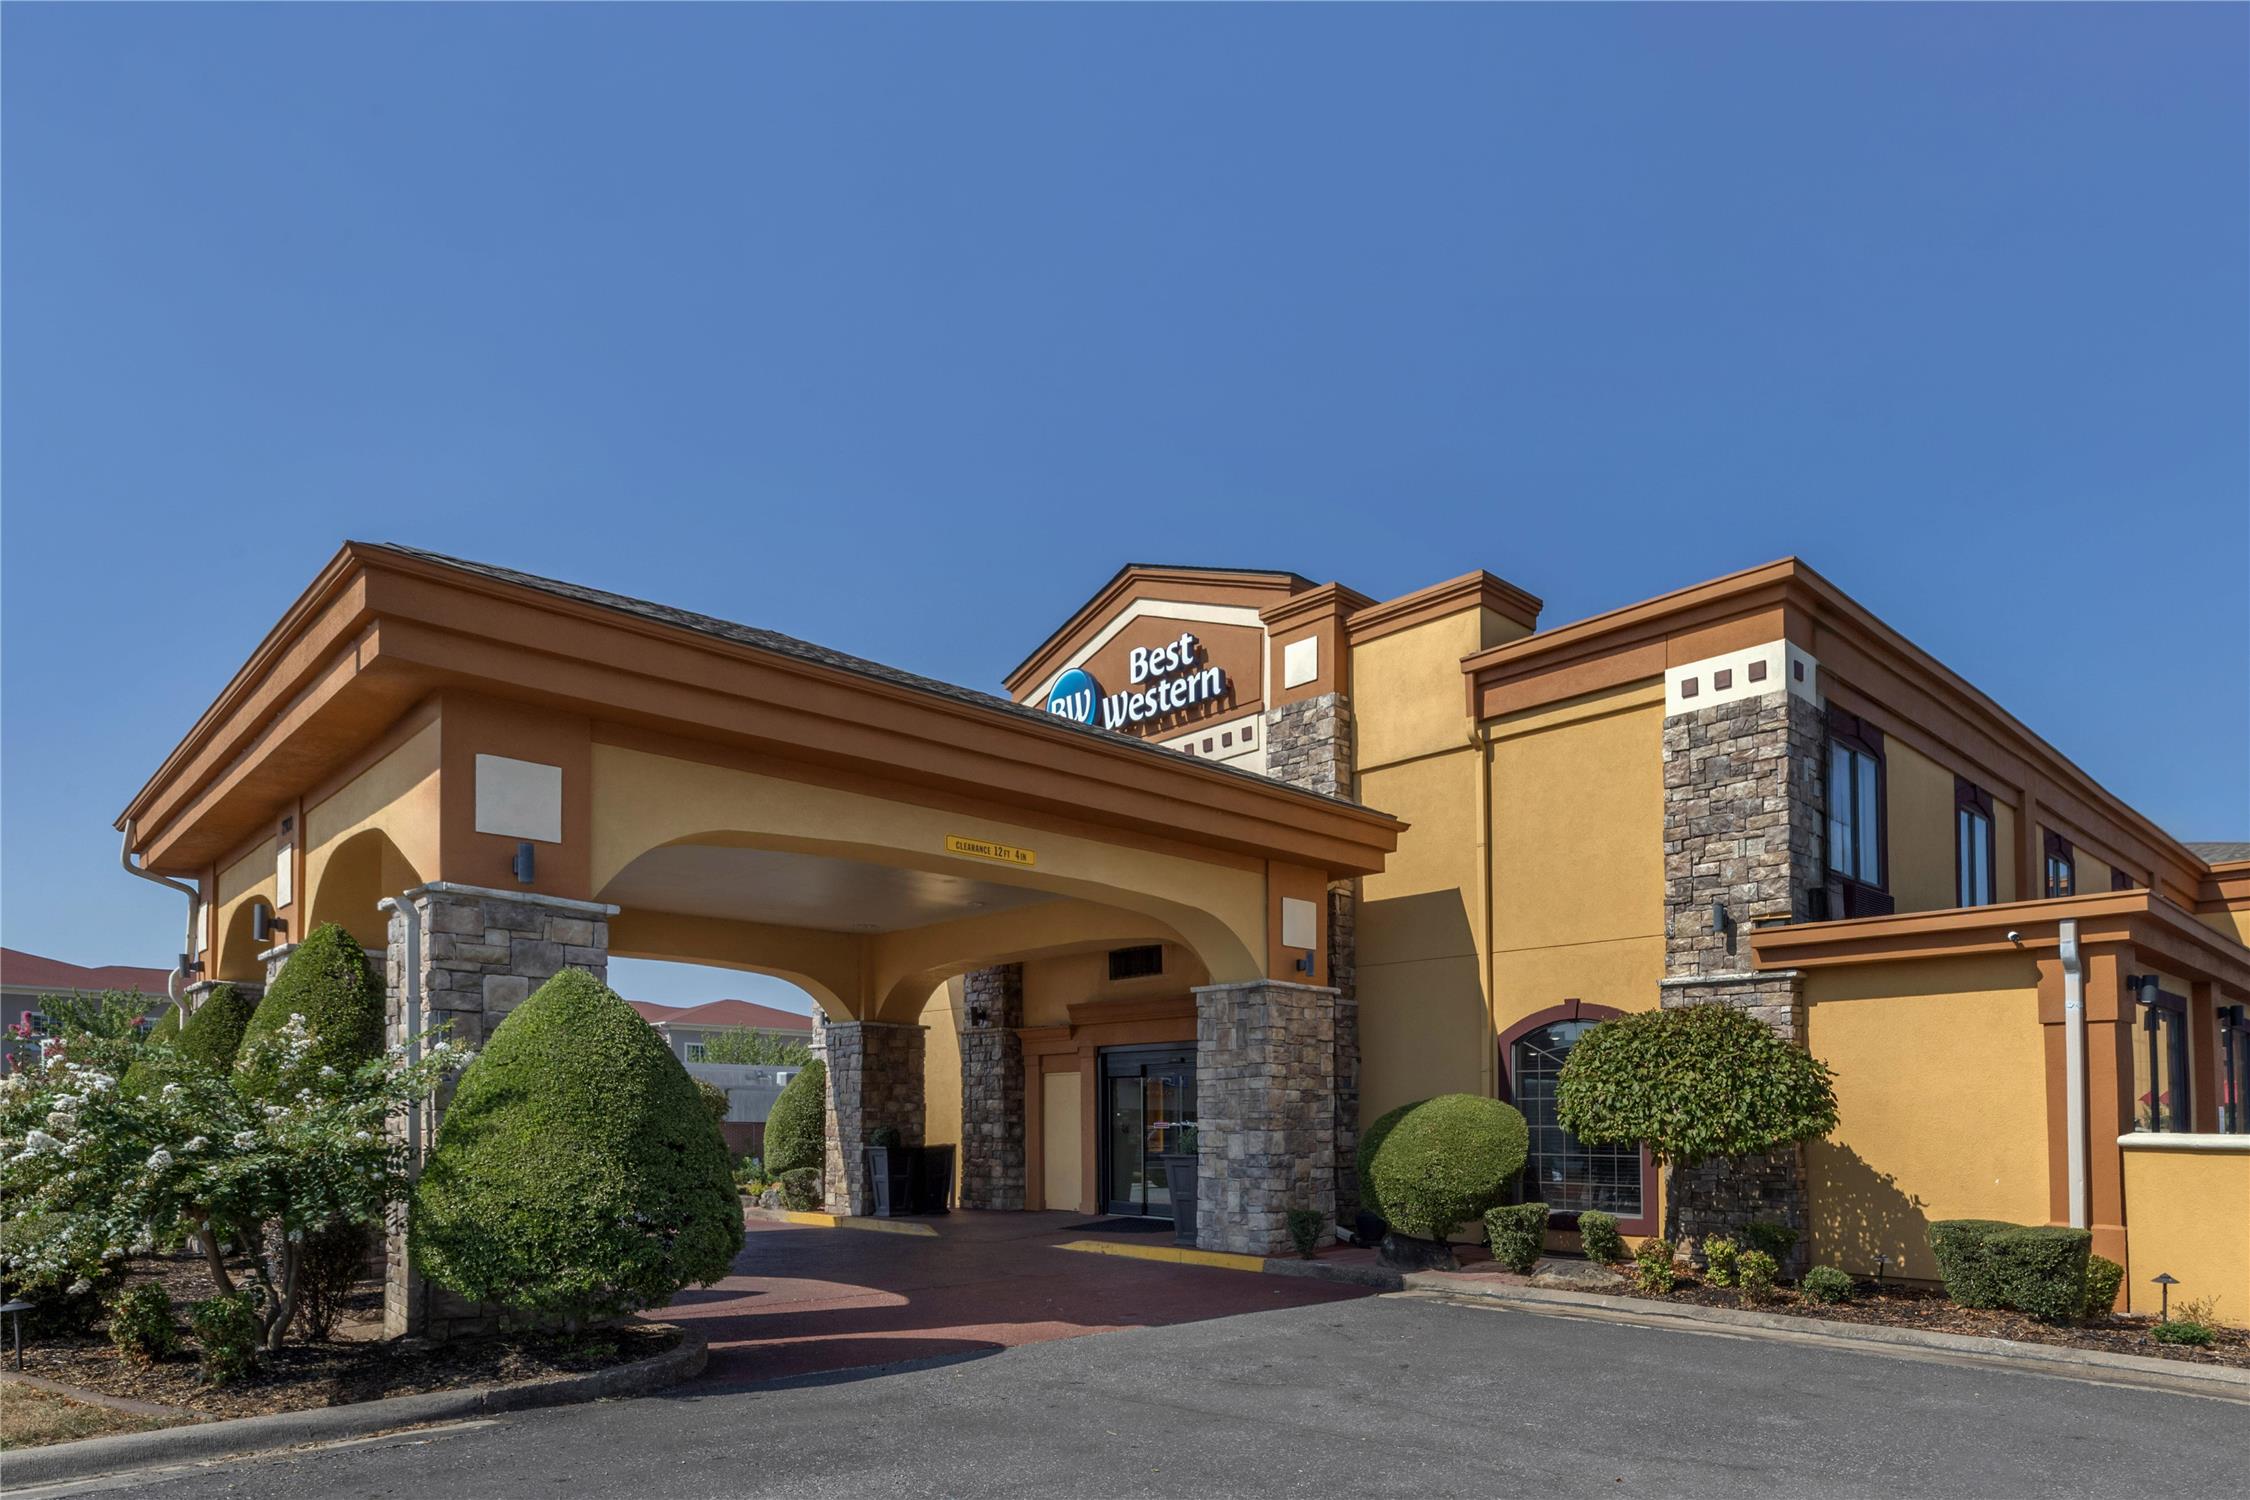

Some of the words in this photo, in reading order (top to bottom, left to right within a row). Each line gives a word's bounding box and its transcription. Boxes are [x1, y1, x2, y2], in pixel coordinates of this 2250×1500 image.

[1130, 632, 1195, 684] Best
[1102, 666, 1223, 730] Western
[955, 841, 991, 856] CLEARANCE
